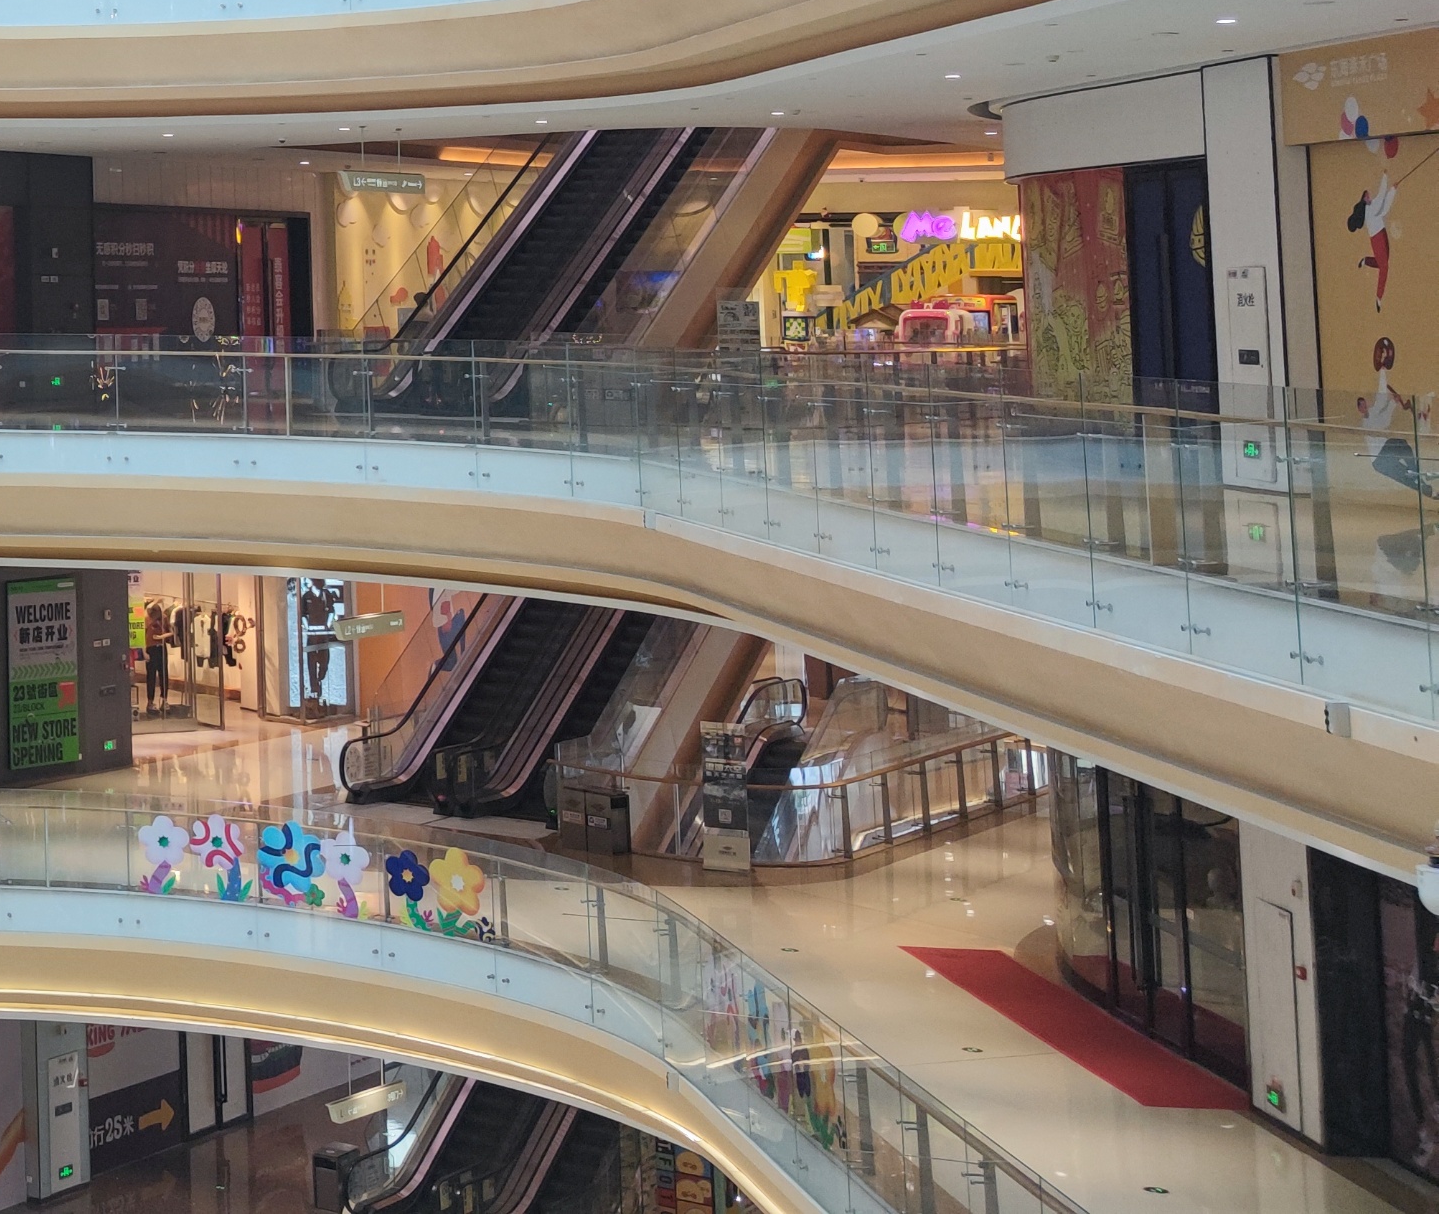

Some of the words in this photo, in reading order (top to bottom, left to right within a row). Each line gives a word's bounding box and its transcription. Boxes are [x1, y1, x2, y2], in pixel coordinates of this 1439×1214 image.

[15, 602, 71, 624] WELCOME
[19, 624, 68, 645] 新店开业
[12, 720, 39, 744] NEW
[42, 717, 77, 739] STORE
[12, 742, 63, 767] OPENING
[89, 1114, 134, 1149] 行25米
